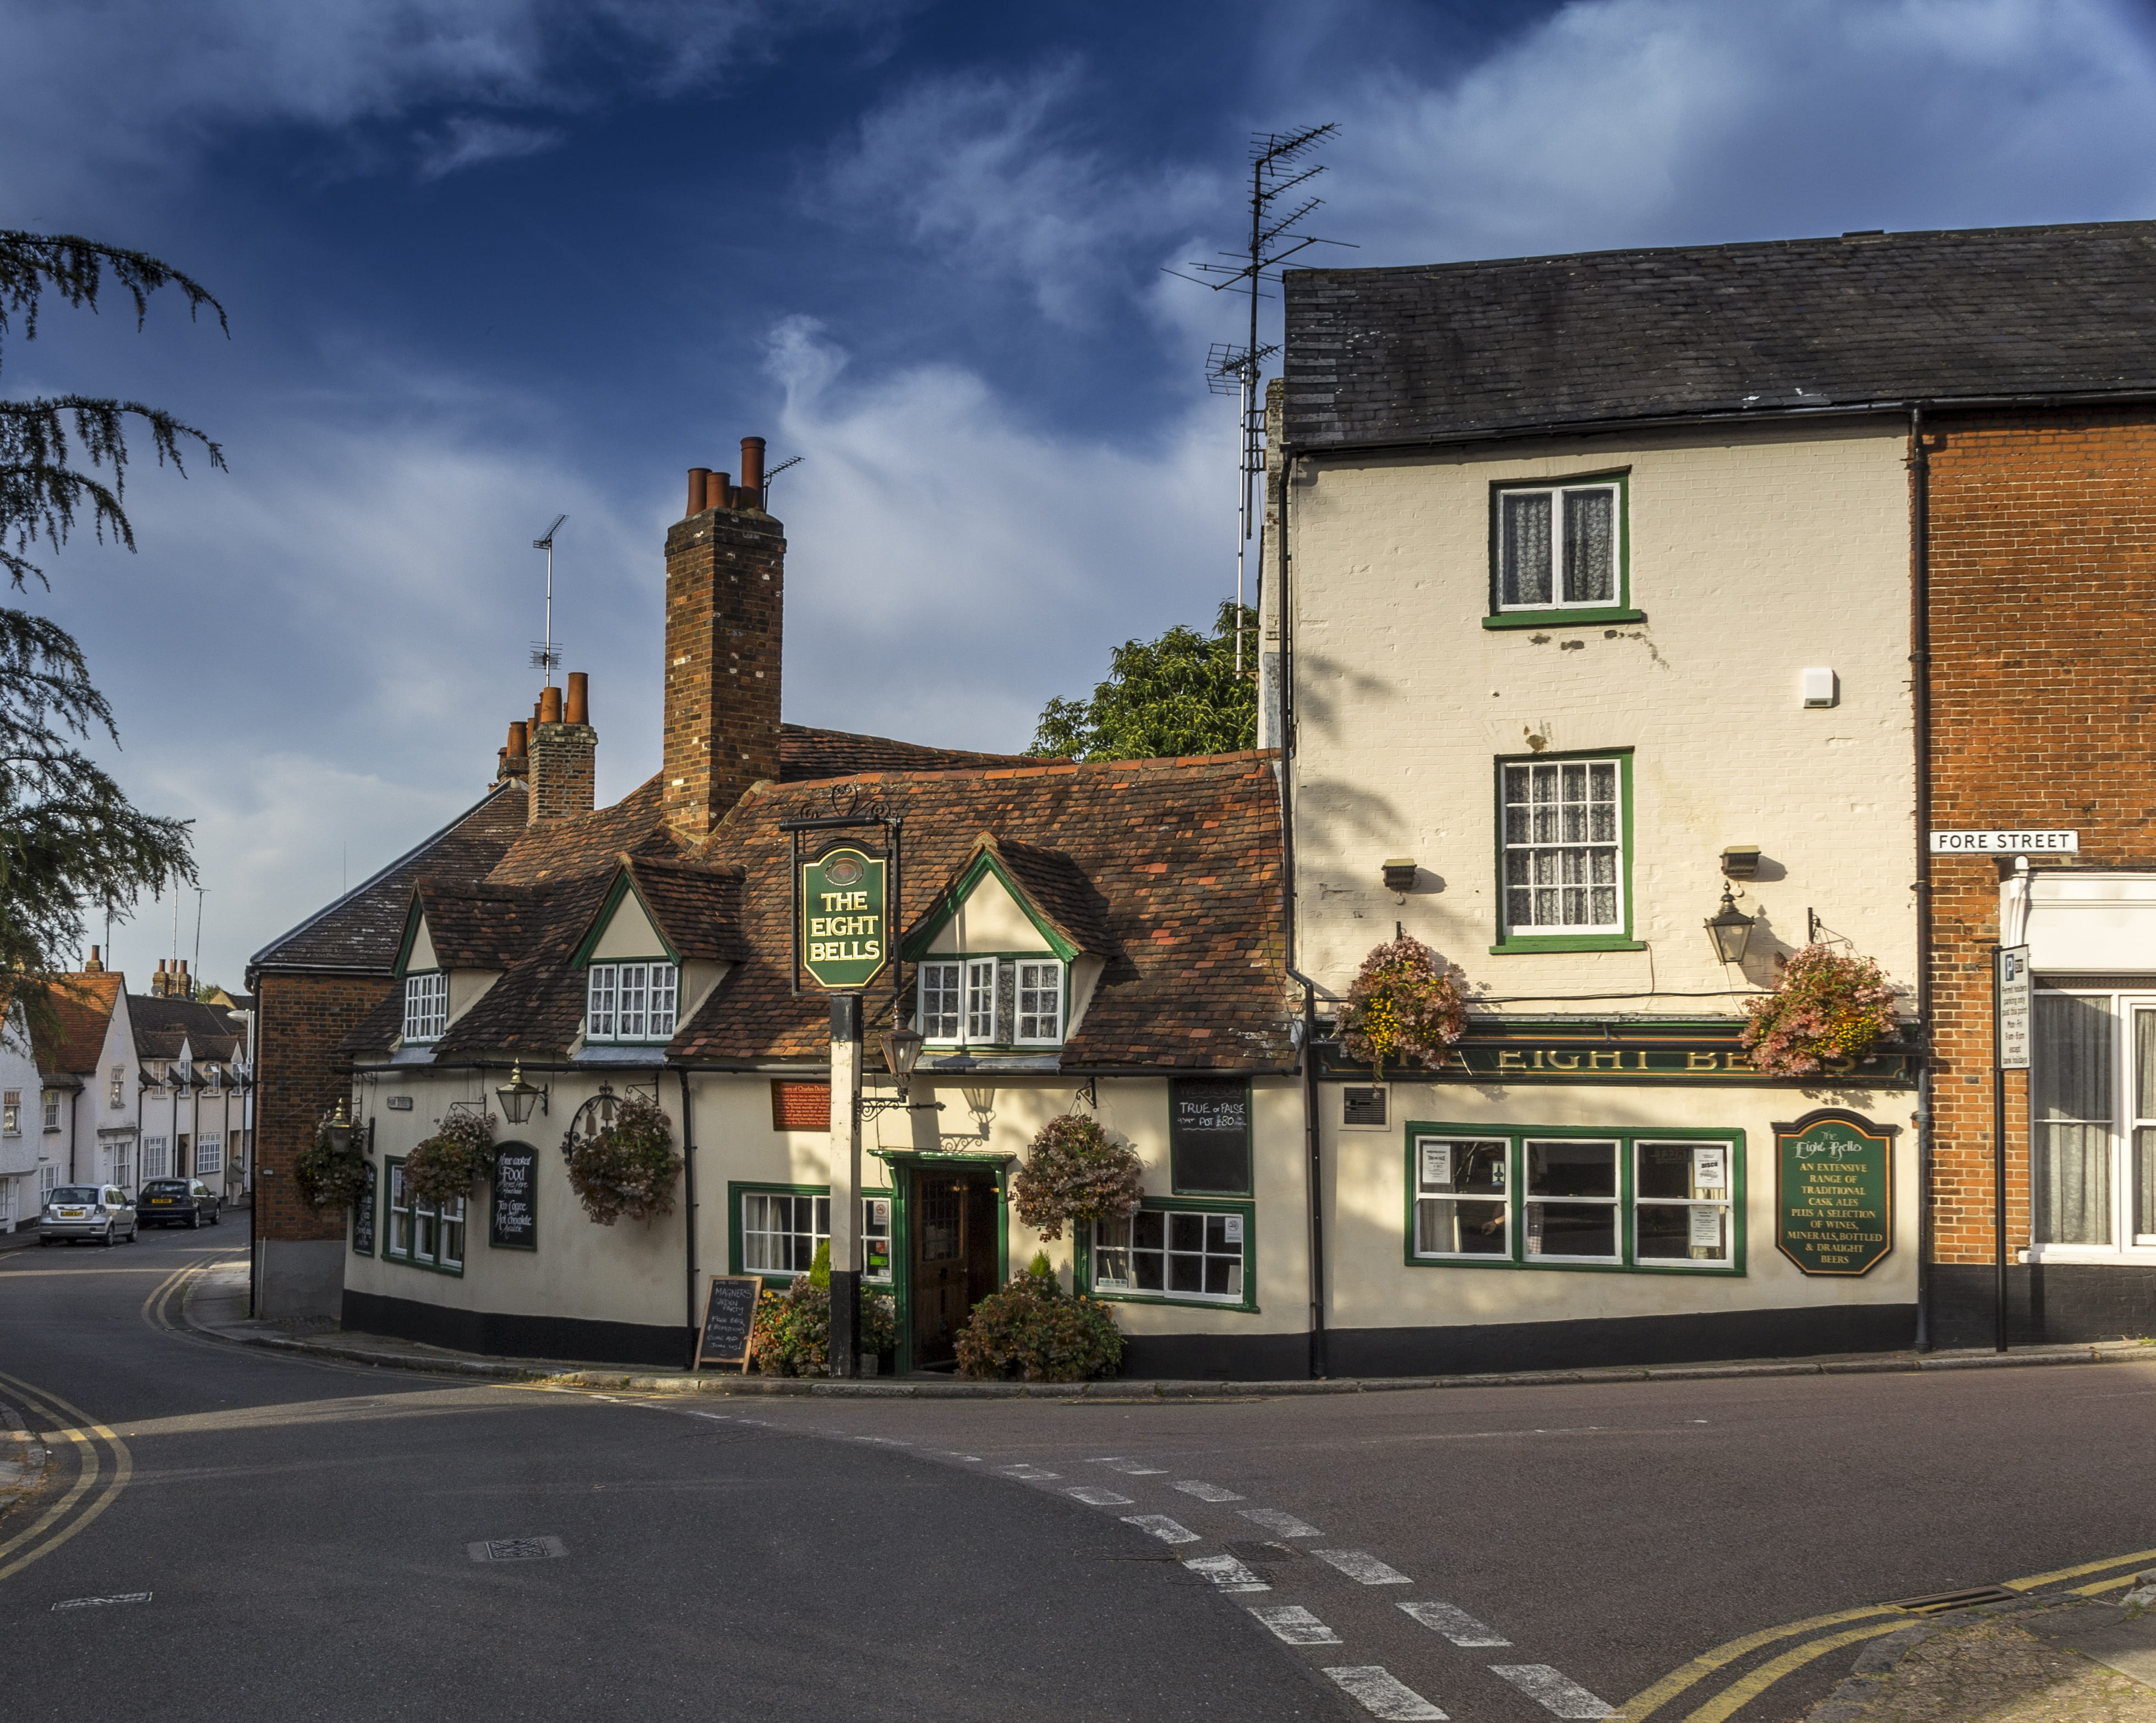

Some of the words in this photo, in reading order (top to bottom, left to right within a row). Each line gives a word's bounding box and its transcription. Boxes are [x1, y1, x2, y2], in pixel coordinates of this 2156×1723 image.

[1939, 834, 1988, 848] FORE
[1997, 834, 2069, 848] STREET
[821, 891, 867, 911] THE
[811, 916, 878, 937] EIGHT
[810, 940, 880, 961] BELLS
[2007, 958, 2013, 979] P
[2002, 985, 2013, 994] Permit
[2014, 984, 2027, 992] holders
[2004, 997, 2017, 1005] parking
[2018, 1006, 2027, 1016] point
[2012, 1055, 2027, 1065] holidays
[1180, 1102, 1211, 1114] TRUE
[1221, 1102, 1246, 1114] FALSE
[1199, 1117, 1214, 1126] POT
[1820, 1130, 1840, 1141] The
[1792, 1141, 1826, 1159] Eight
[1827, 1141, 1862, 1161] Bells
[1800, 1163, 1814, 1171] AN
[1817, 1163, 1868, 1172] EXTENSIVE
[500, 1166, 525, 1182] Food
[1810, 1174, 1842, 1183] RANGE
[1845, 1175, 1858, 1183] OF
[1801, 1186, 1867, 1195] TRADITIONAL
[1808, 1197, 1833, 1206] CASK
[1791, 1208, 1814, 1217] PLUS
[1827, 1210, 1876, 1218] SELECTION
[1810, 1220, 1823, 1228] OF
[1826, 1221, 1859, 1230] WINES,
[1787, 1231, 1839, 1241] MINERALS,
[1840, 1233, 1882, 1241] BOTTLED
[1817, 1244, 1864, 1252] DRAUGHT
[1821, 1255, 1849, 1263] BEERS
[716, 1287, 752, 1299] MAGNERS
[723, 1306, 744, 1316] PARTY
